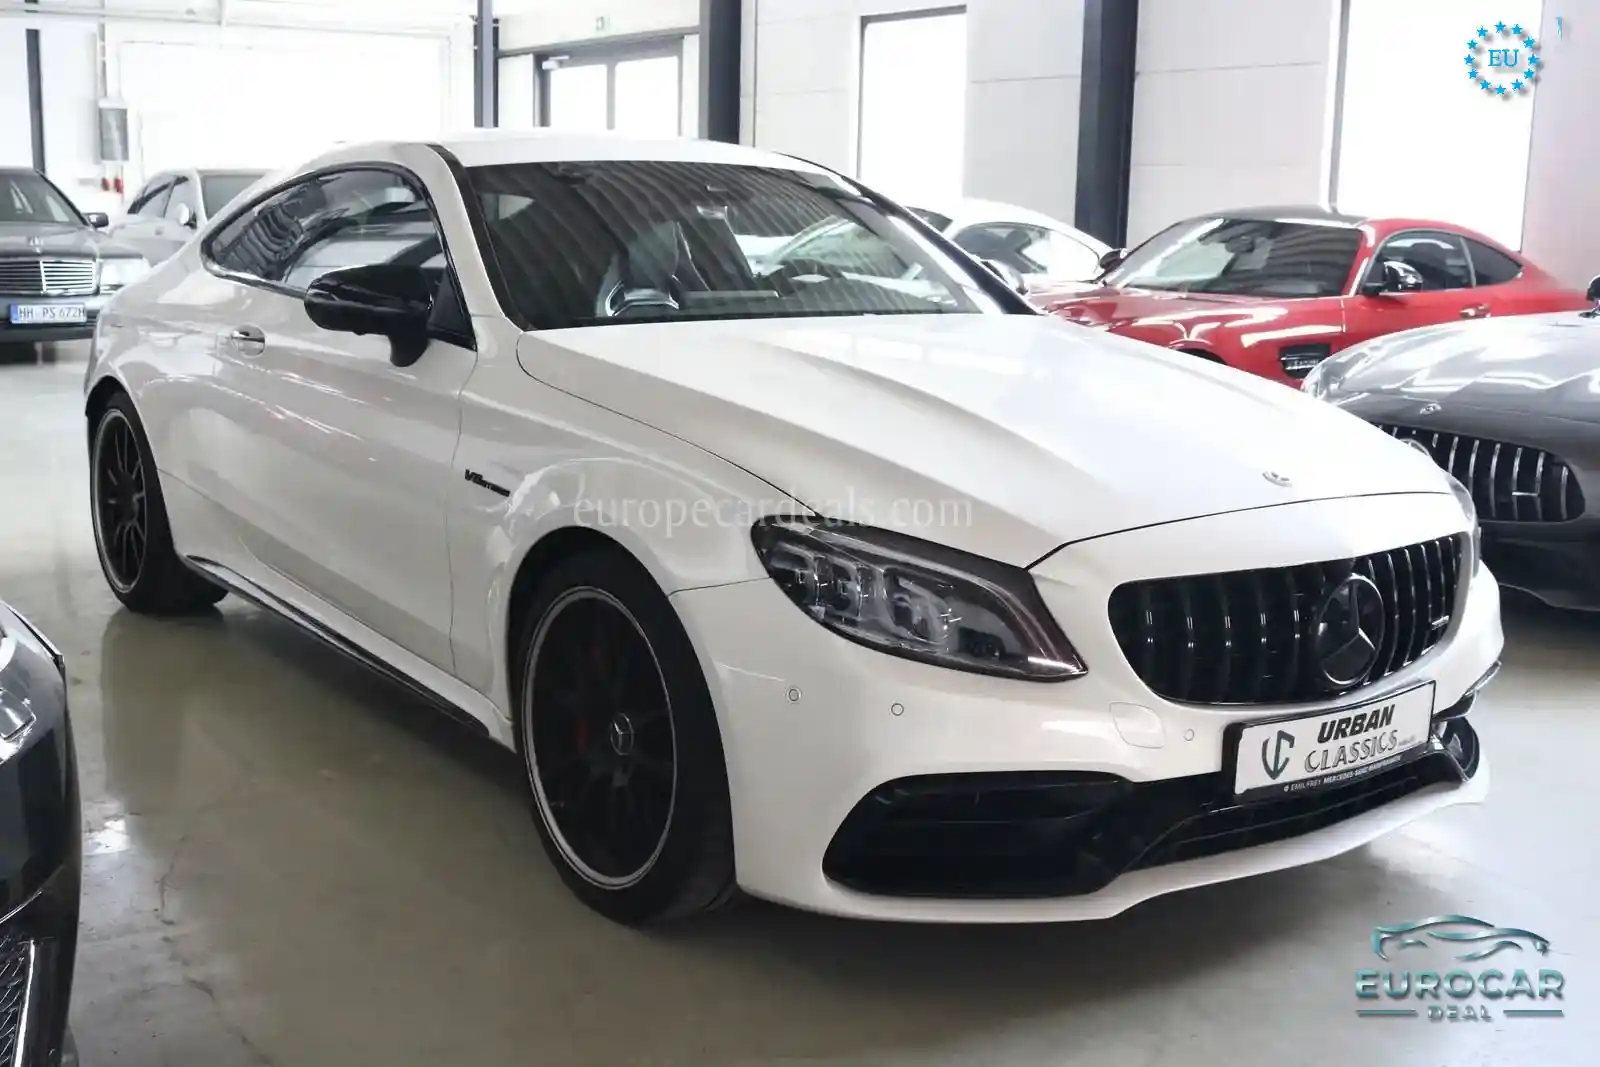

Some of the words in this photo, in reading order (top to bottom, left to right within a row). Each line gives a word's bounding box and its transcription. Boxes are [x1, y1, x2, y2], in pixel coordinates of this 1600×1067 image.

[43, 306, 56, 318] PS
[1317, 703, 1396, 744] URBAN
[1304, 729, 1398, 773] CLASSICS
